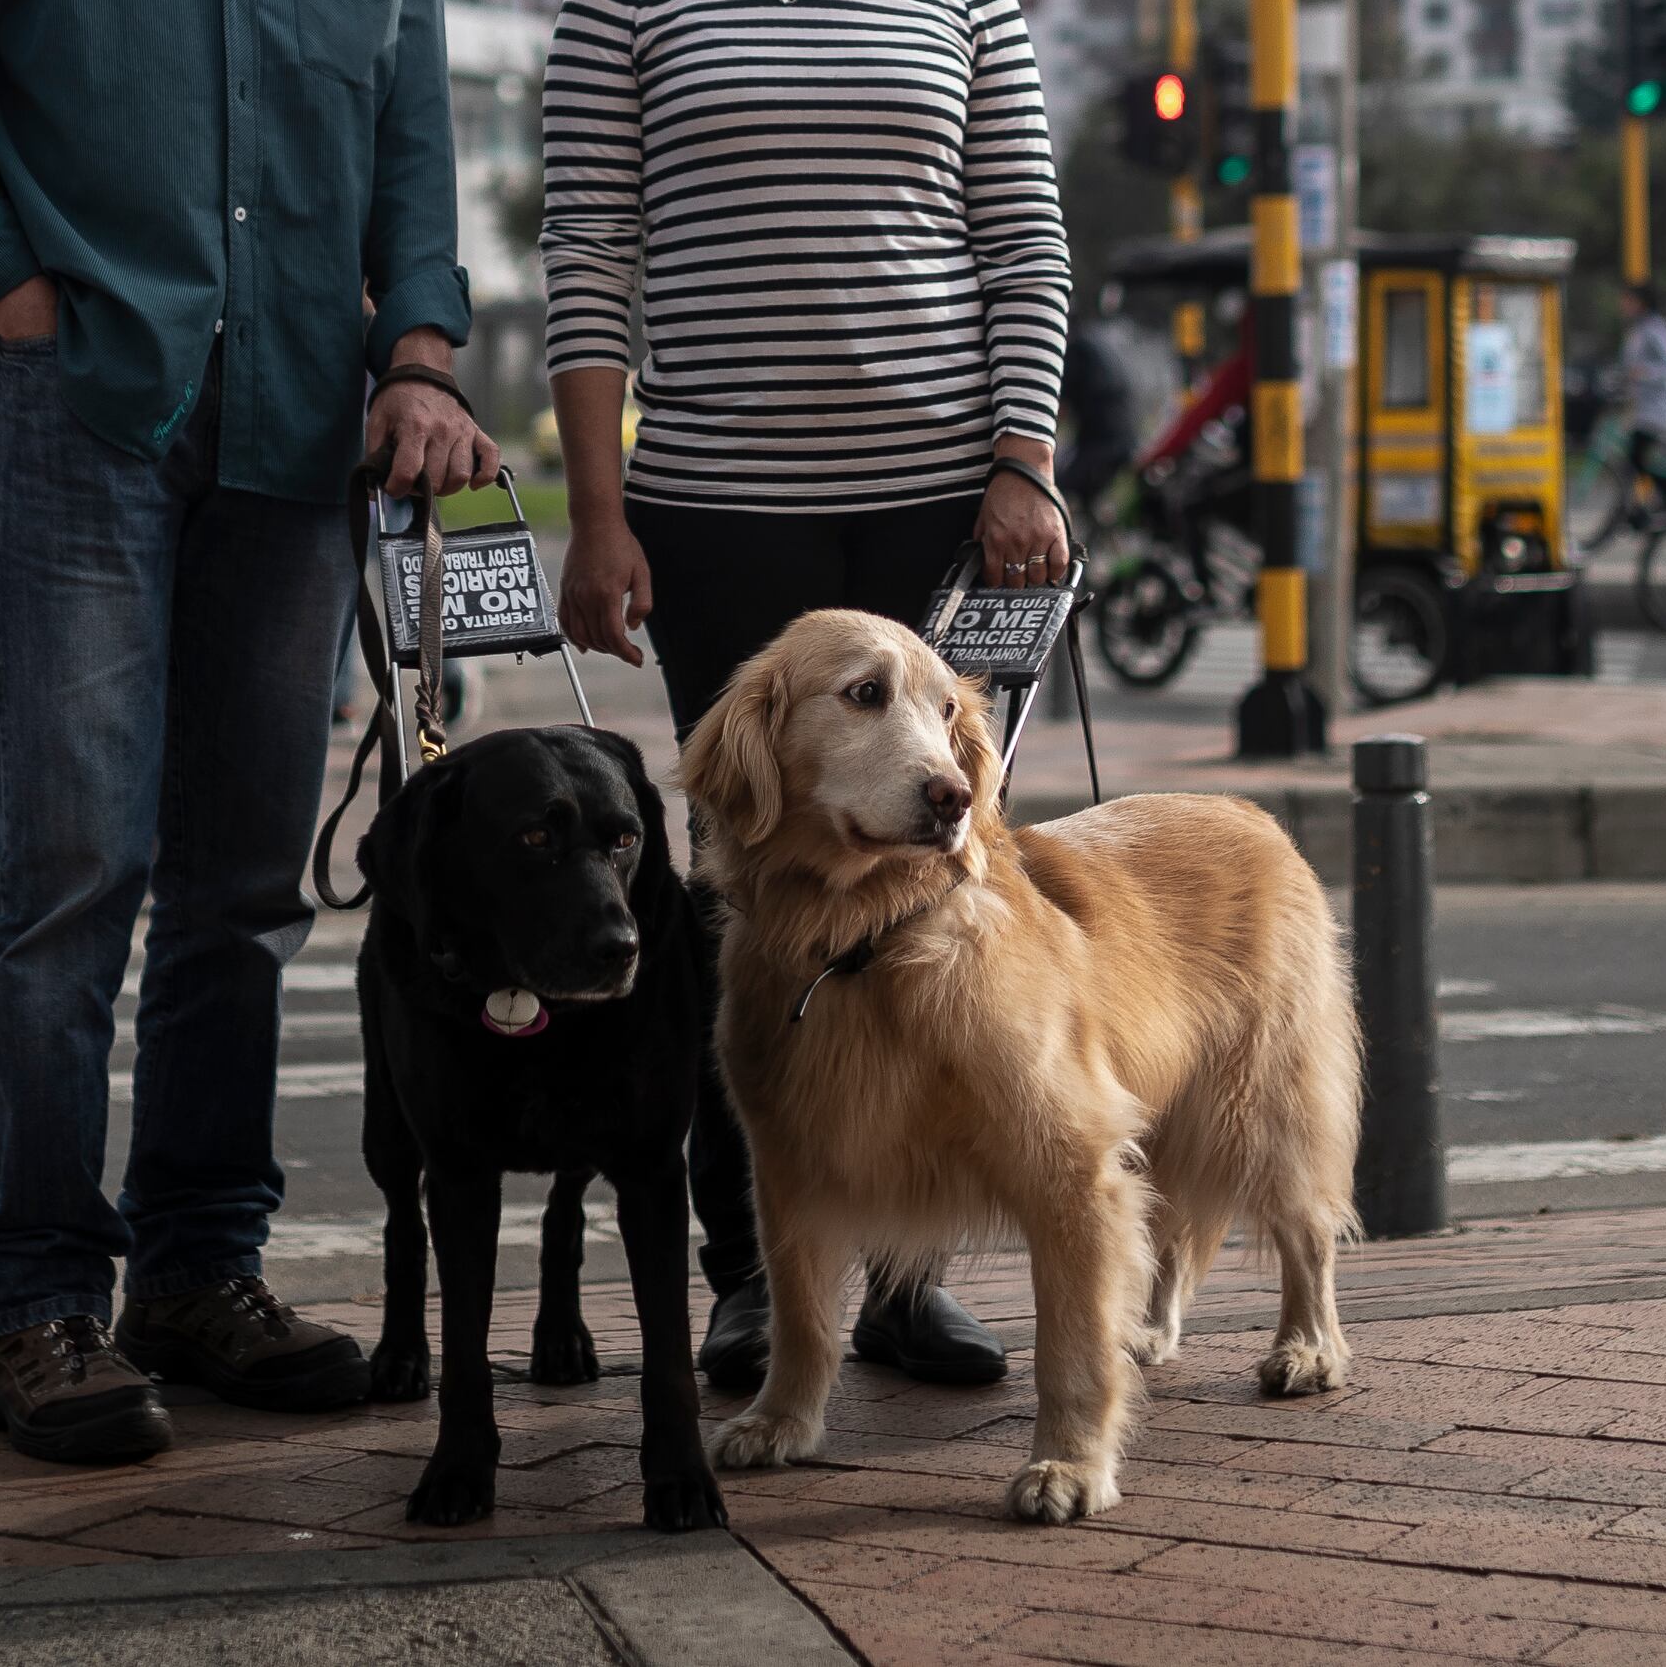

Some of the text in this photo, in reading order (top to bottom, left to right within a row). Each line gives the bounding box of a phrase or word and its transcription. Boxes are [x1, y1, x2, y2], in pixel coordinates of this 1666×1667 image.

[402, 547, 528, 573] ESTOY TRABADO
[403, 565, 530, 598] ACARICS
[480, 588, 538, 613] NO
[935, 595, 1051, 610] PRRITA GUÍA
[464, 611, 534, 628] PERRITA
[989, 610, 1048, 629] ME
[949, 647, 1028, 661] TRABAJANDO
